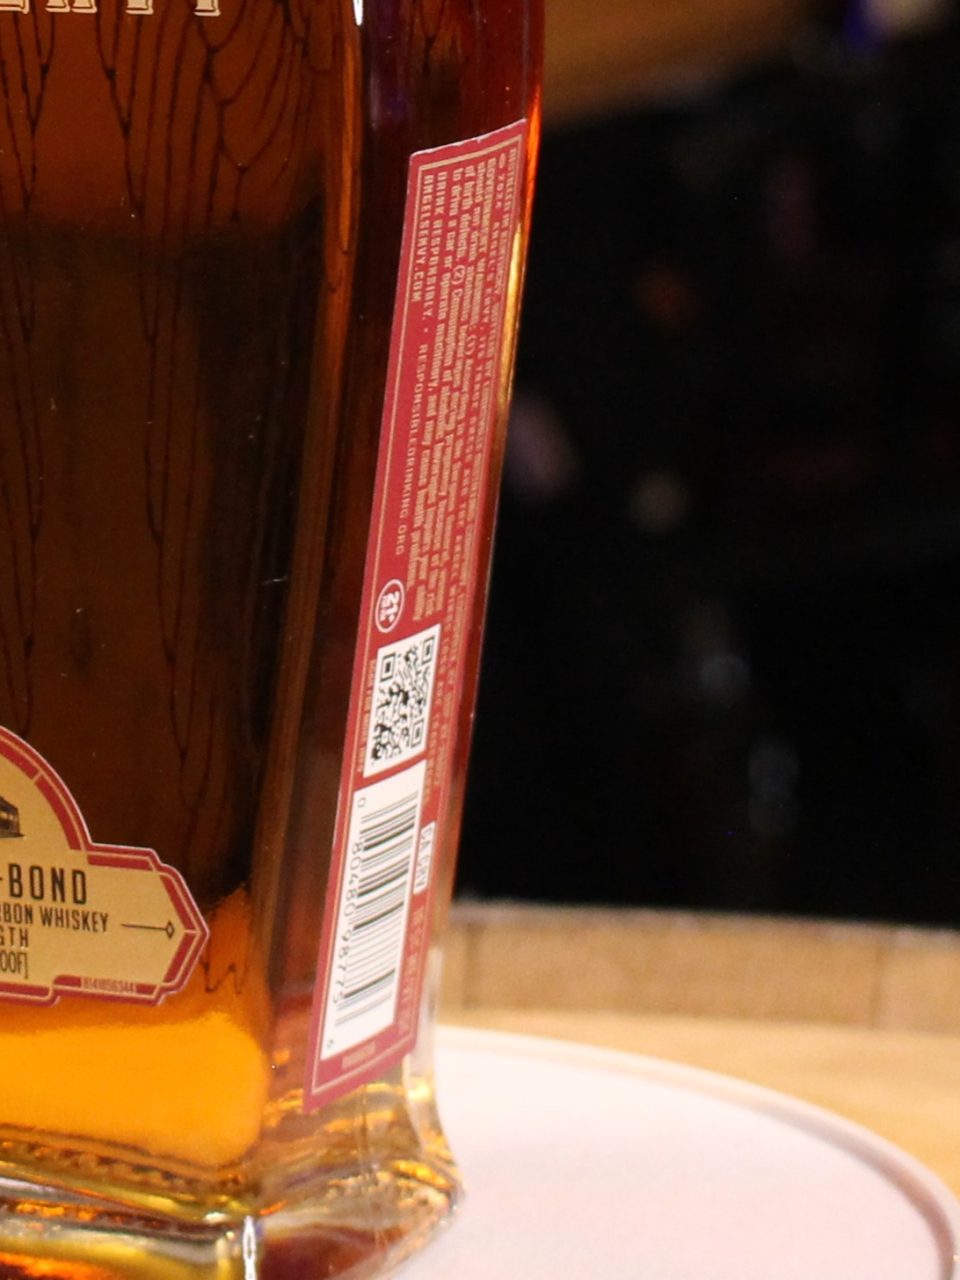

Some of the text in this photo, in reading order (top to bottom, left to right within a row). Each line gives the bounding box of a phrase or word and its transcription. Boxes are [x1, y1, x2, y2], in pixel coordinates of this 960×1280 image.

[434, 171, 447, 215] DRINK
[451, 264, 466, 285] (2)
[344, 840, 364, 918] 80480
[40, 905, 109, 933] WHISKEY
